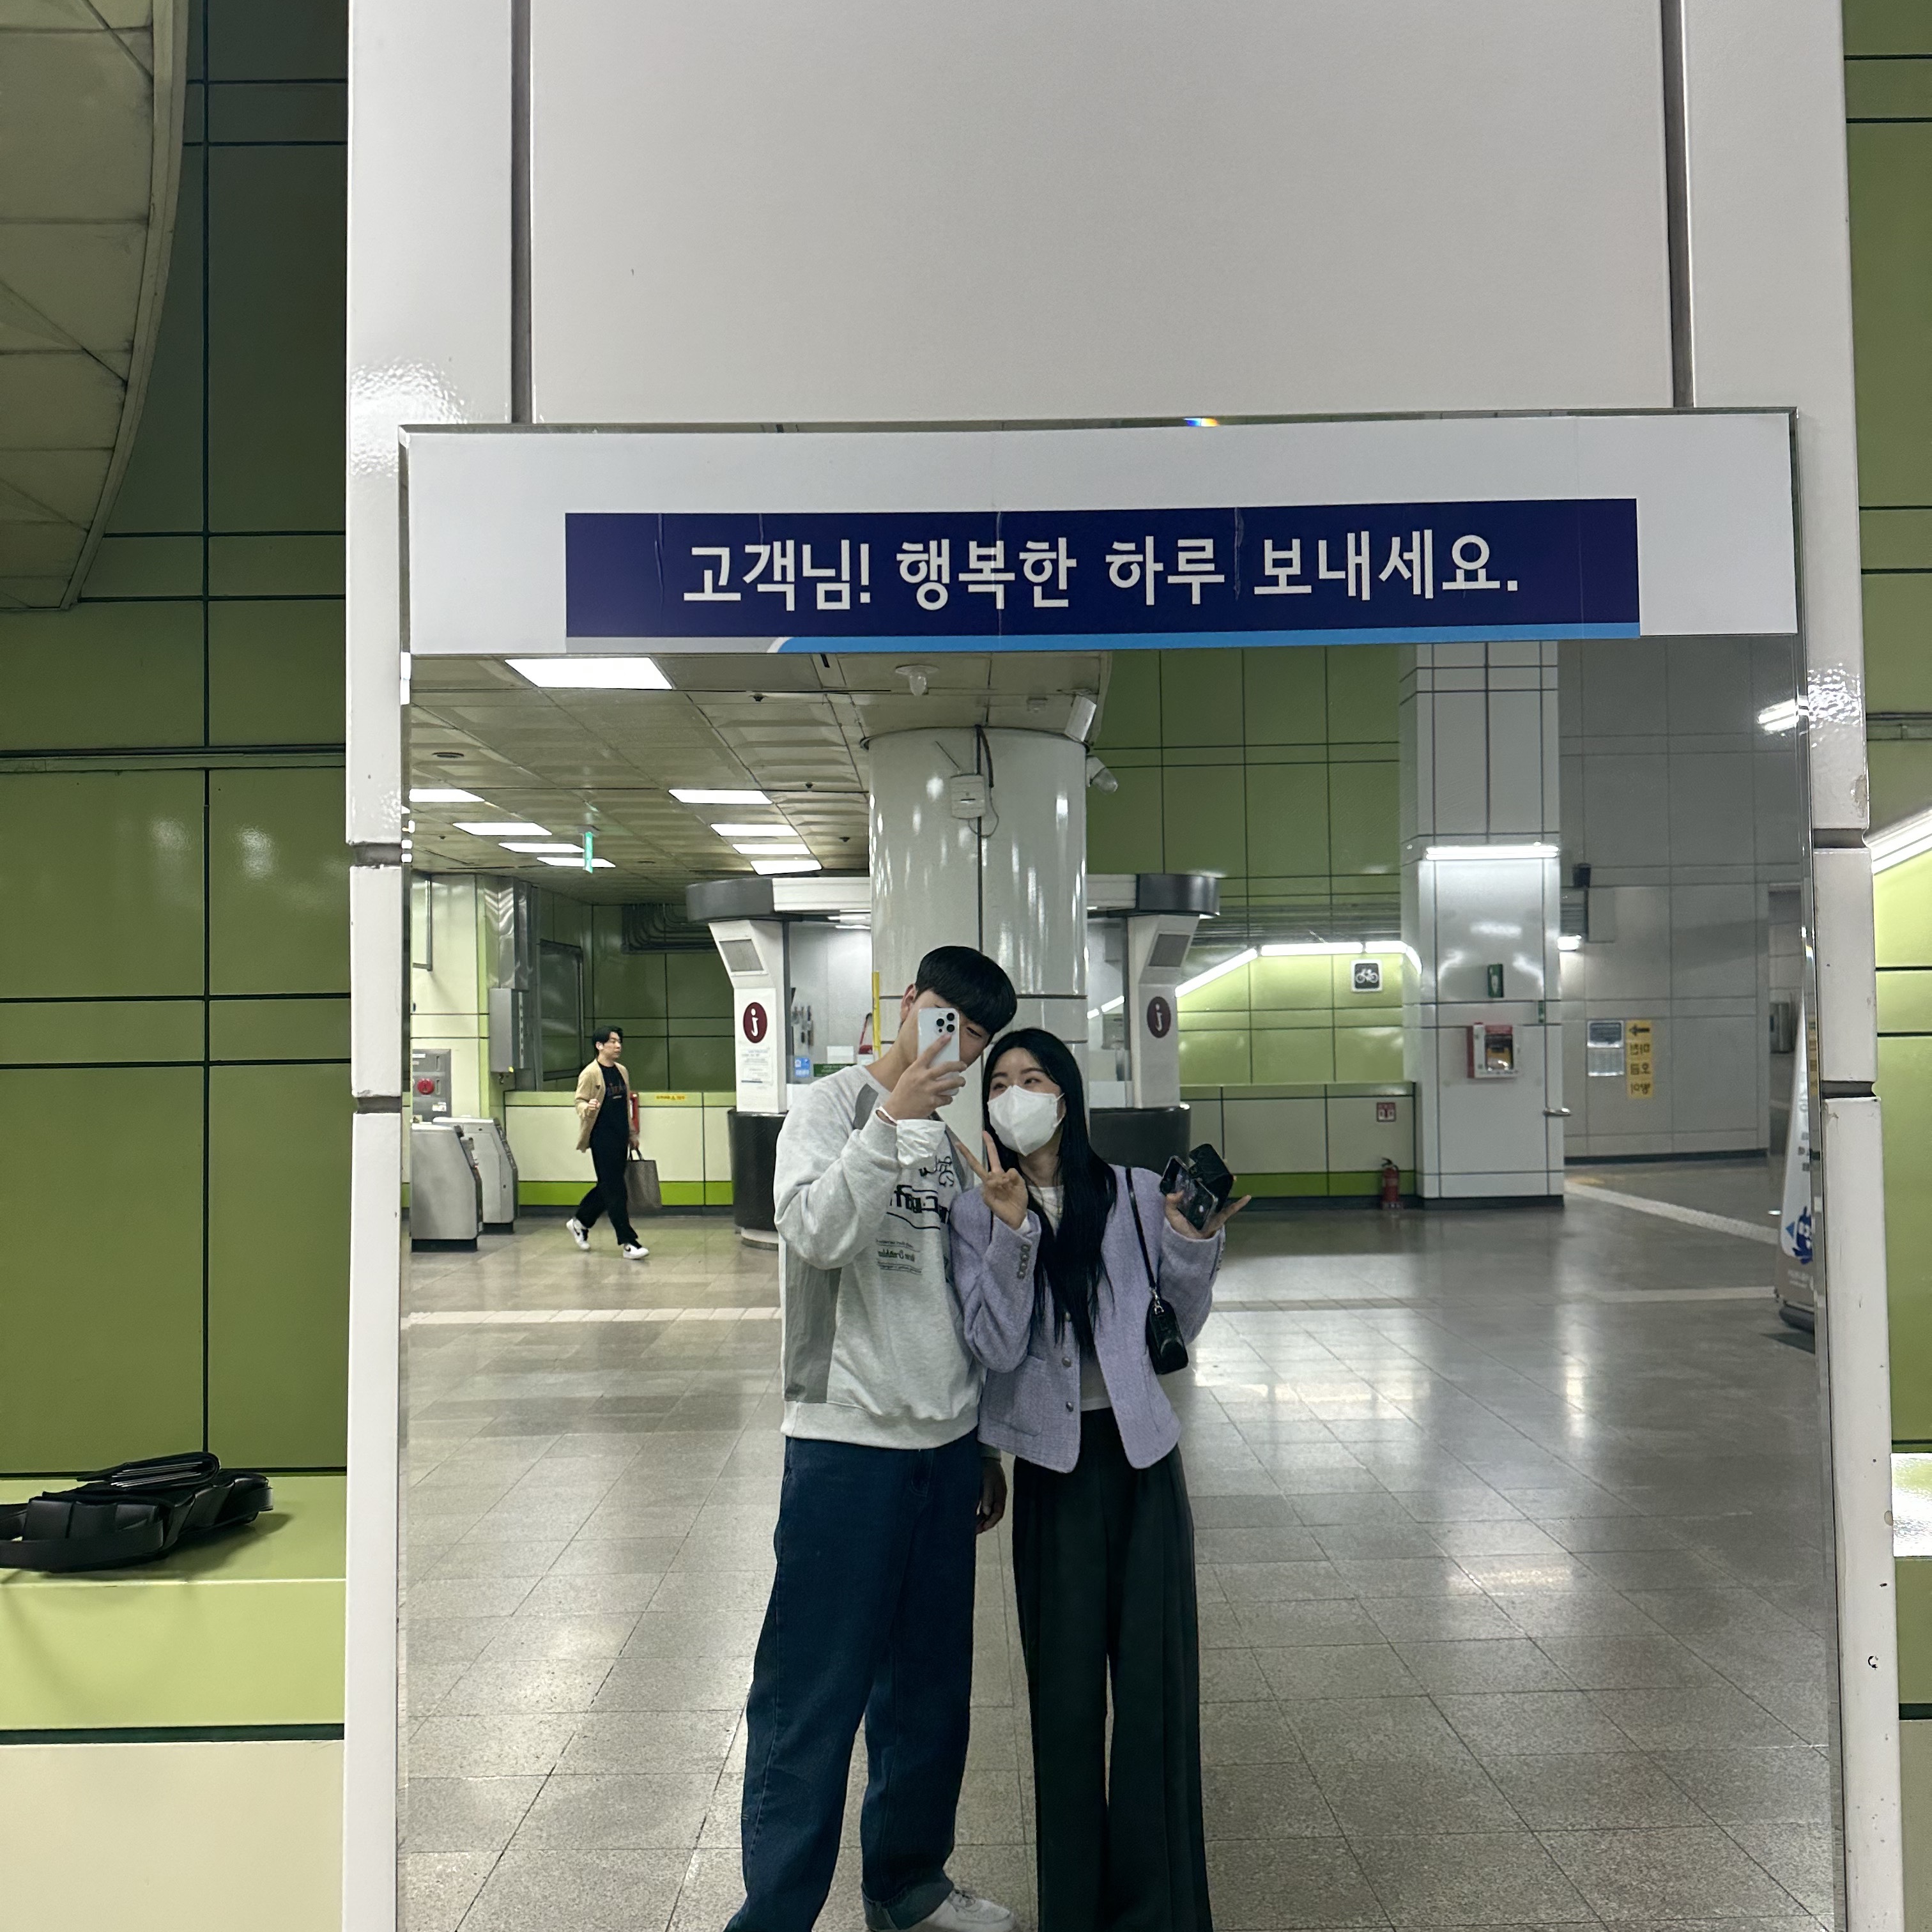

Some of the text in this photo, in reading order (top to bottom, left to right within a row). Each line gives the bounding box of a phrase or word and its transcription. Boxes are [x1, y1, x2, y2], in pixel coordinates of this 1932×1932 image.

[683, 529, 1518, 611] 고객님! 행복한 하루 보내세요.
